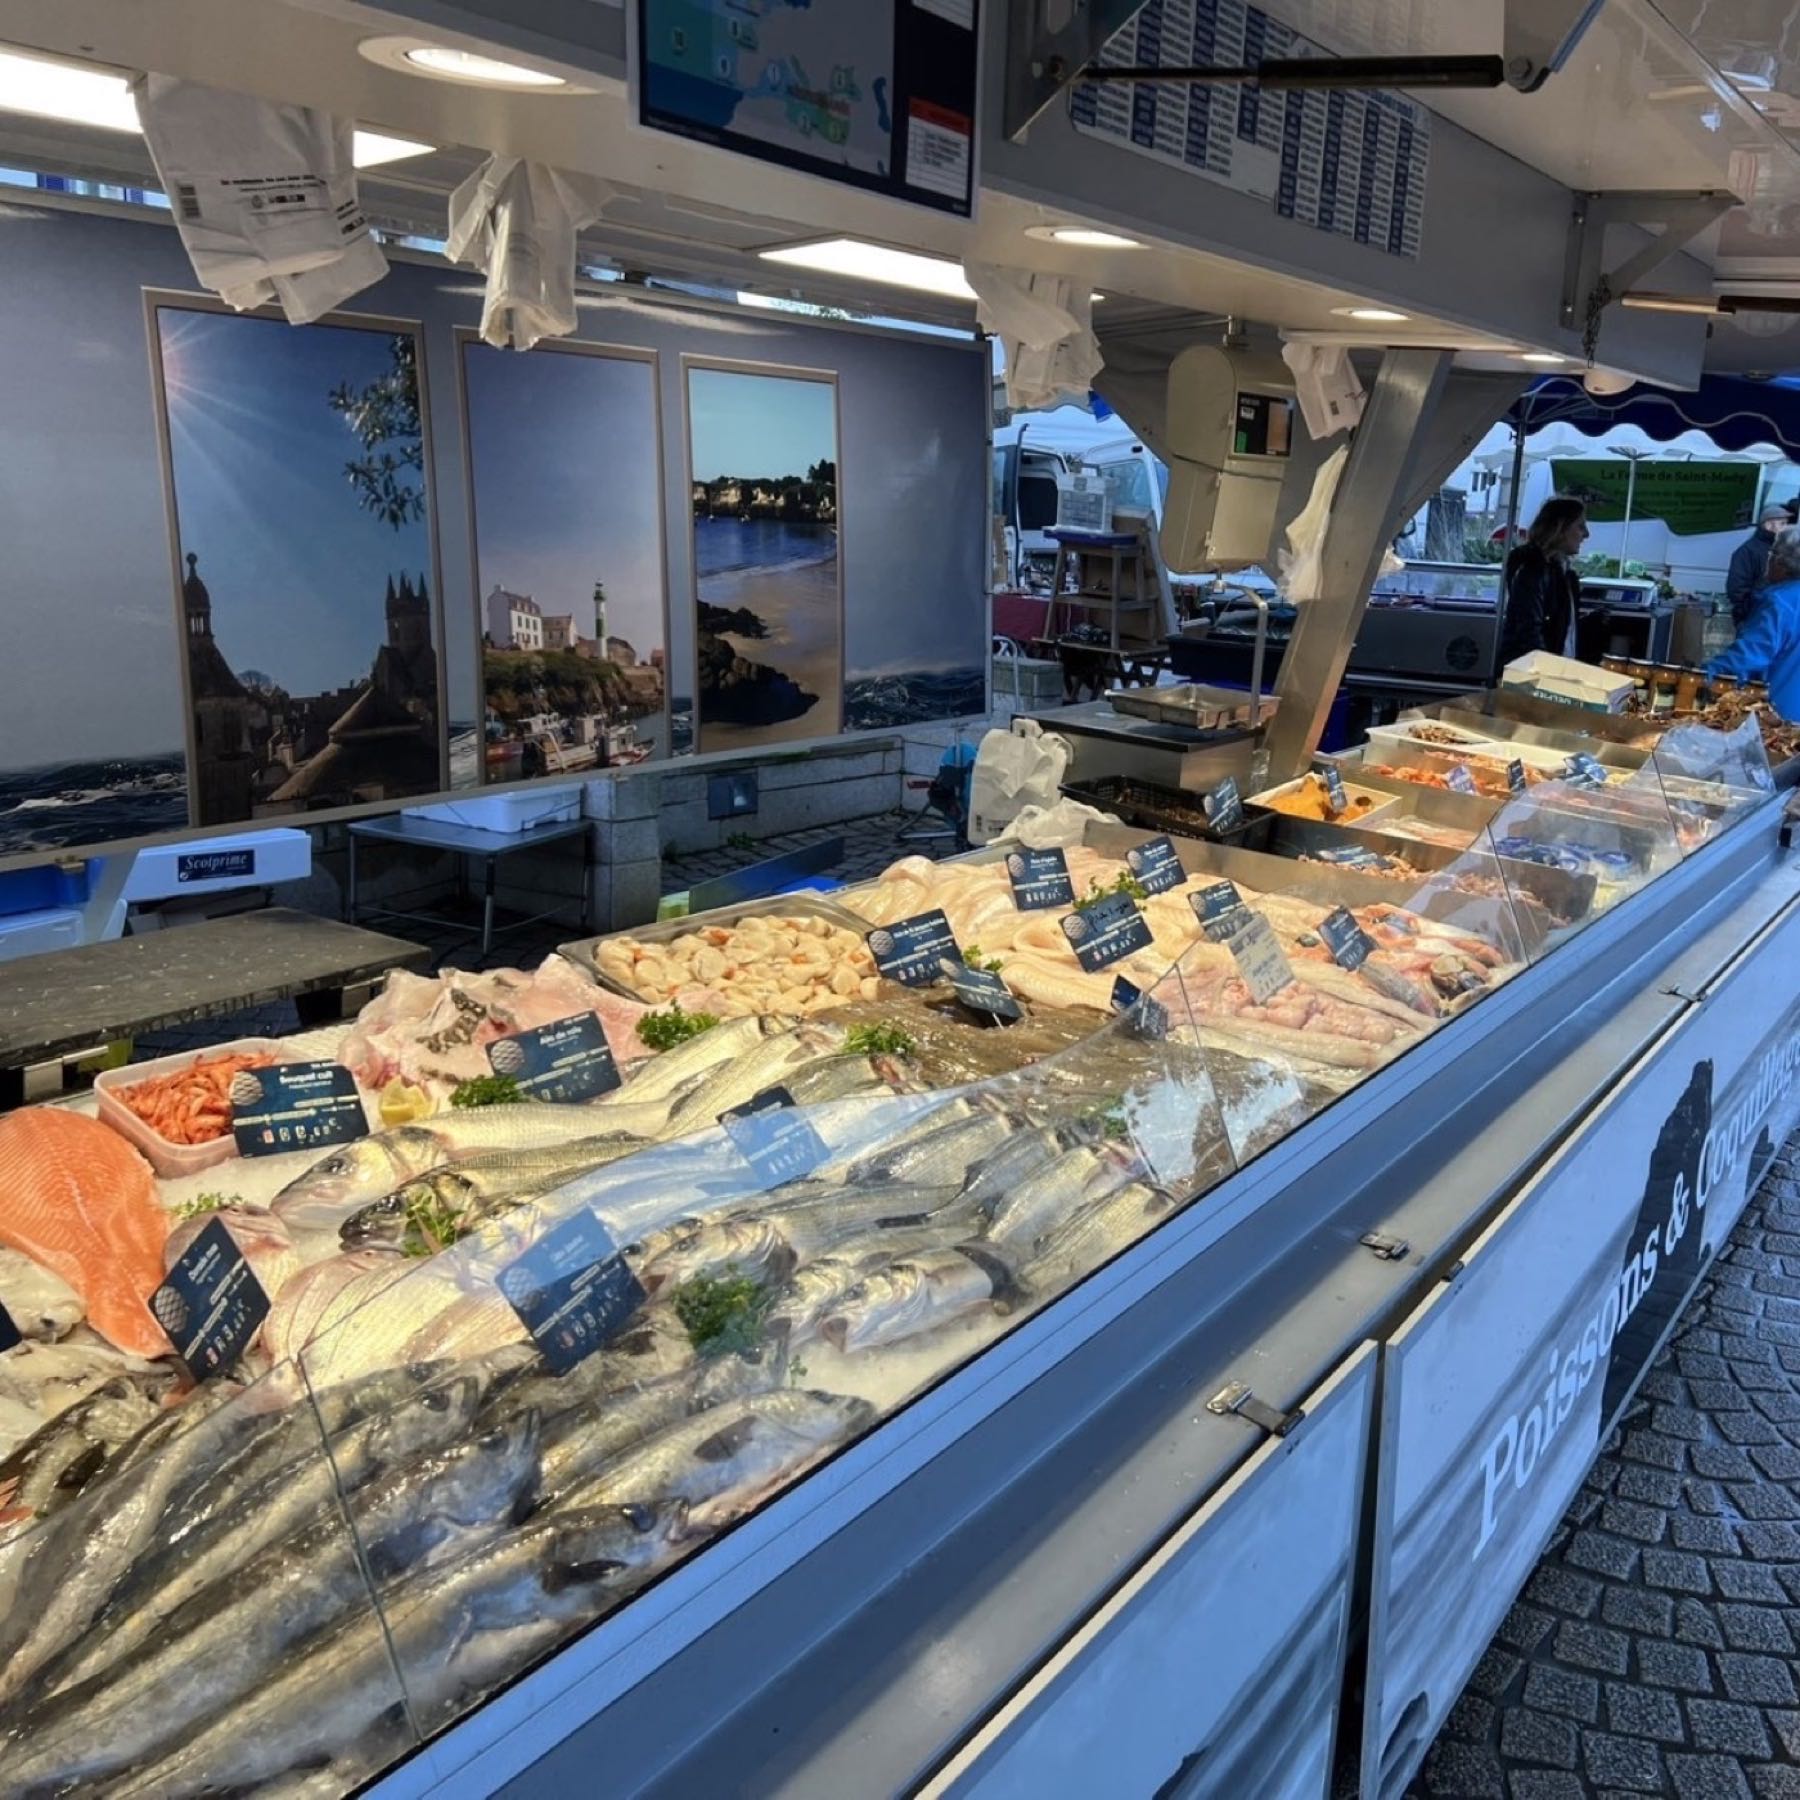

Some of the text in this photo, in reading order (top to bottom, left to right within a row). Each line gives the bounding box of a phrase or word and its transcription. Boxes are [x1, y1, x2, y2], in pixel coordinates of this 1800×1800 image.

[1600, 468, 1614, 481] La
[1472, 1224, 1661, 1562] Poissons
[1665, 1171, 1691, 1256] &
